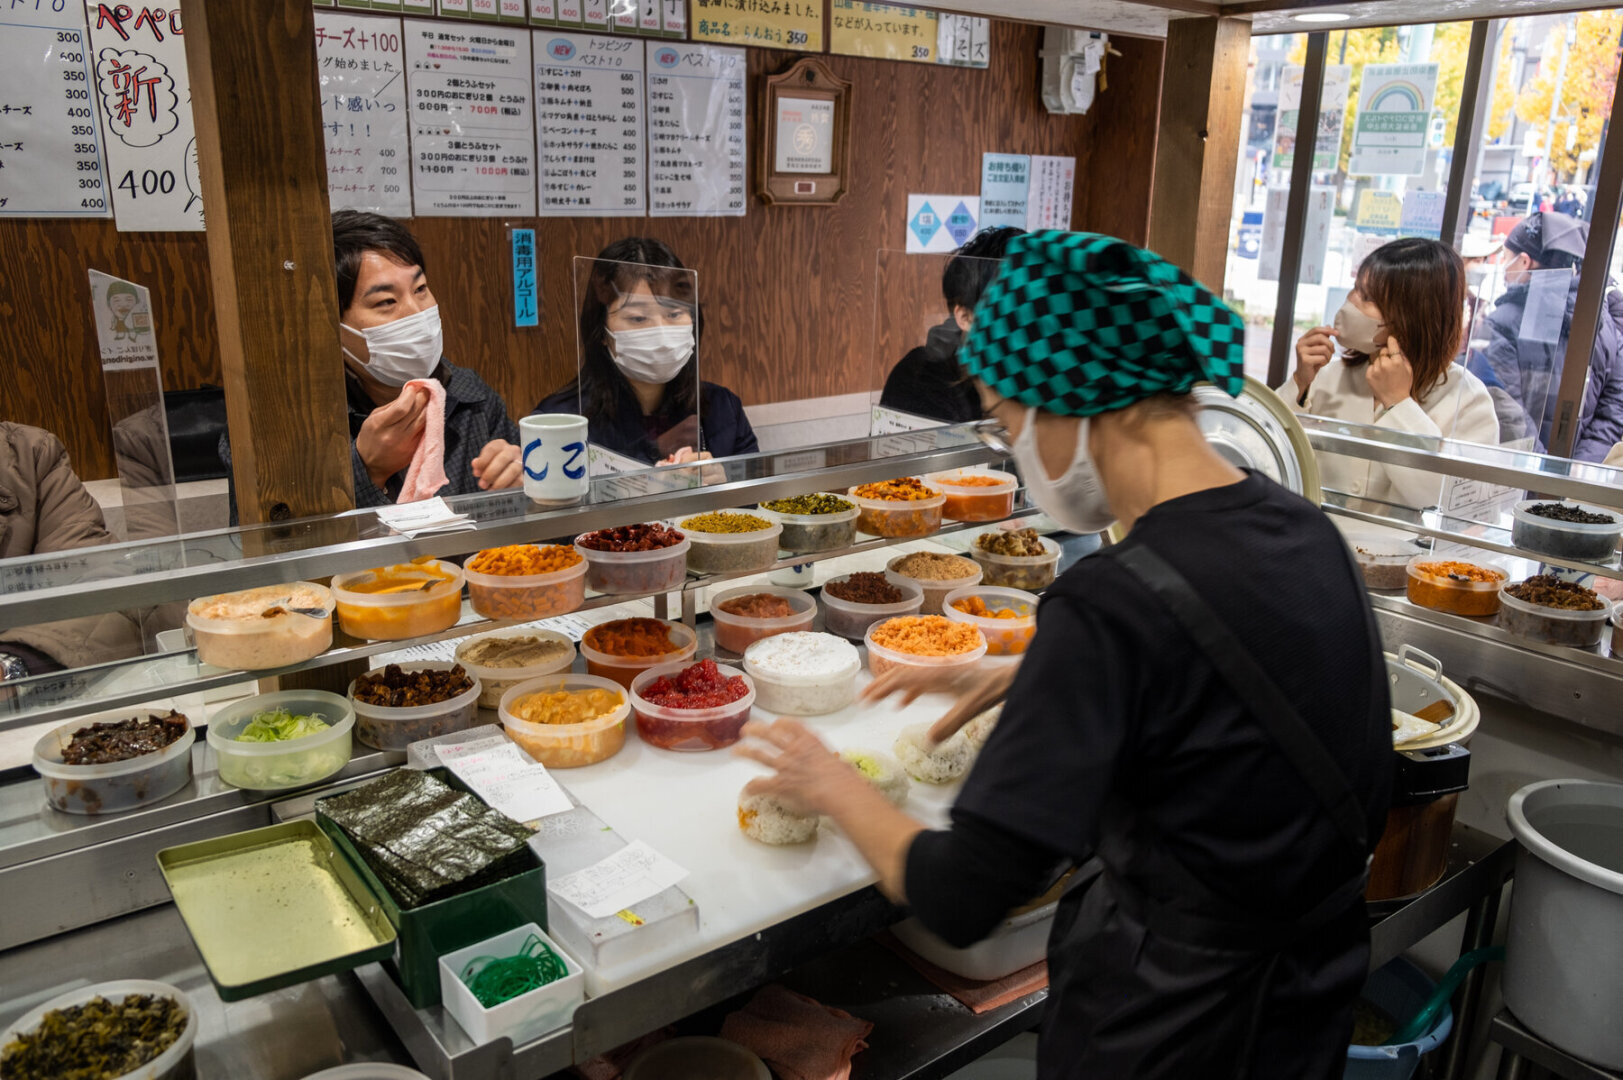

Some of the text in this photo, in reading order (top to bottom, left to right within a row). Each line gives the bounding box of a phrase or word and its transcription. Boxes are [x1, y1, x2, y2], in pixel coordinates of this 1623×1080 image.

[503, 3, 520, 11] 350
[535, 6, 551, 14] 400
[562, 8, 578, 17] 400
[834, 16, 924, 37] などが入っています。
[57, 32, 80, 42] 300
[786, 30, 808, 44] 350
[554, 44, 572, 56] NEW
[590, 38, 632, 52] トッピング
[912, 46, 930, 58] 350
[660, 53, 677, 64] NEW
[318, 56, 402, 73] グ始めました。
[63, 70, 86, 81] 350
[65, 89, 88, 100] 300
[108, 59, 162, 127] 新
[0, 104, 91, 118] チーズ 400
[470, 105, 498, 114] 700円
[622, 116, 636, 124] 400
[72, 126, 94, 136] 350
[622, 129, 636, 137] 400
[74, 144, 96, 154] 350
[379, 149, 396, 158] 400
[76, 161, 98, 171] 350
[381, 166, 397, 175] 700
[623, 170, 636, 178] 350
[78, 179, 101, 189] 300
[118, 169, 176, 199] 400
[384, 185, 400, 193] 500
[624, 184, 636, 192] 450
[81, 198, 104, 208] 400
[515, 232, 536, 319] 消毒用アルコール
